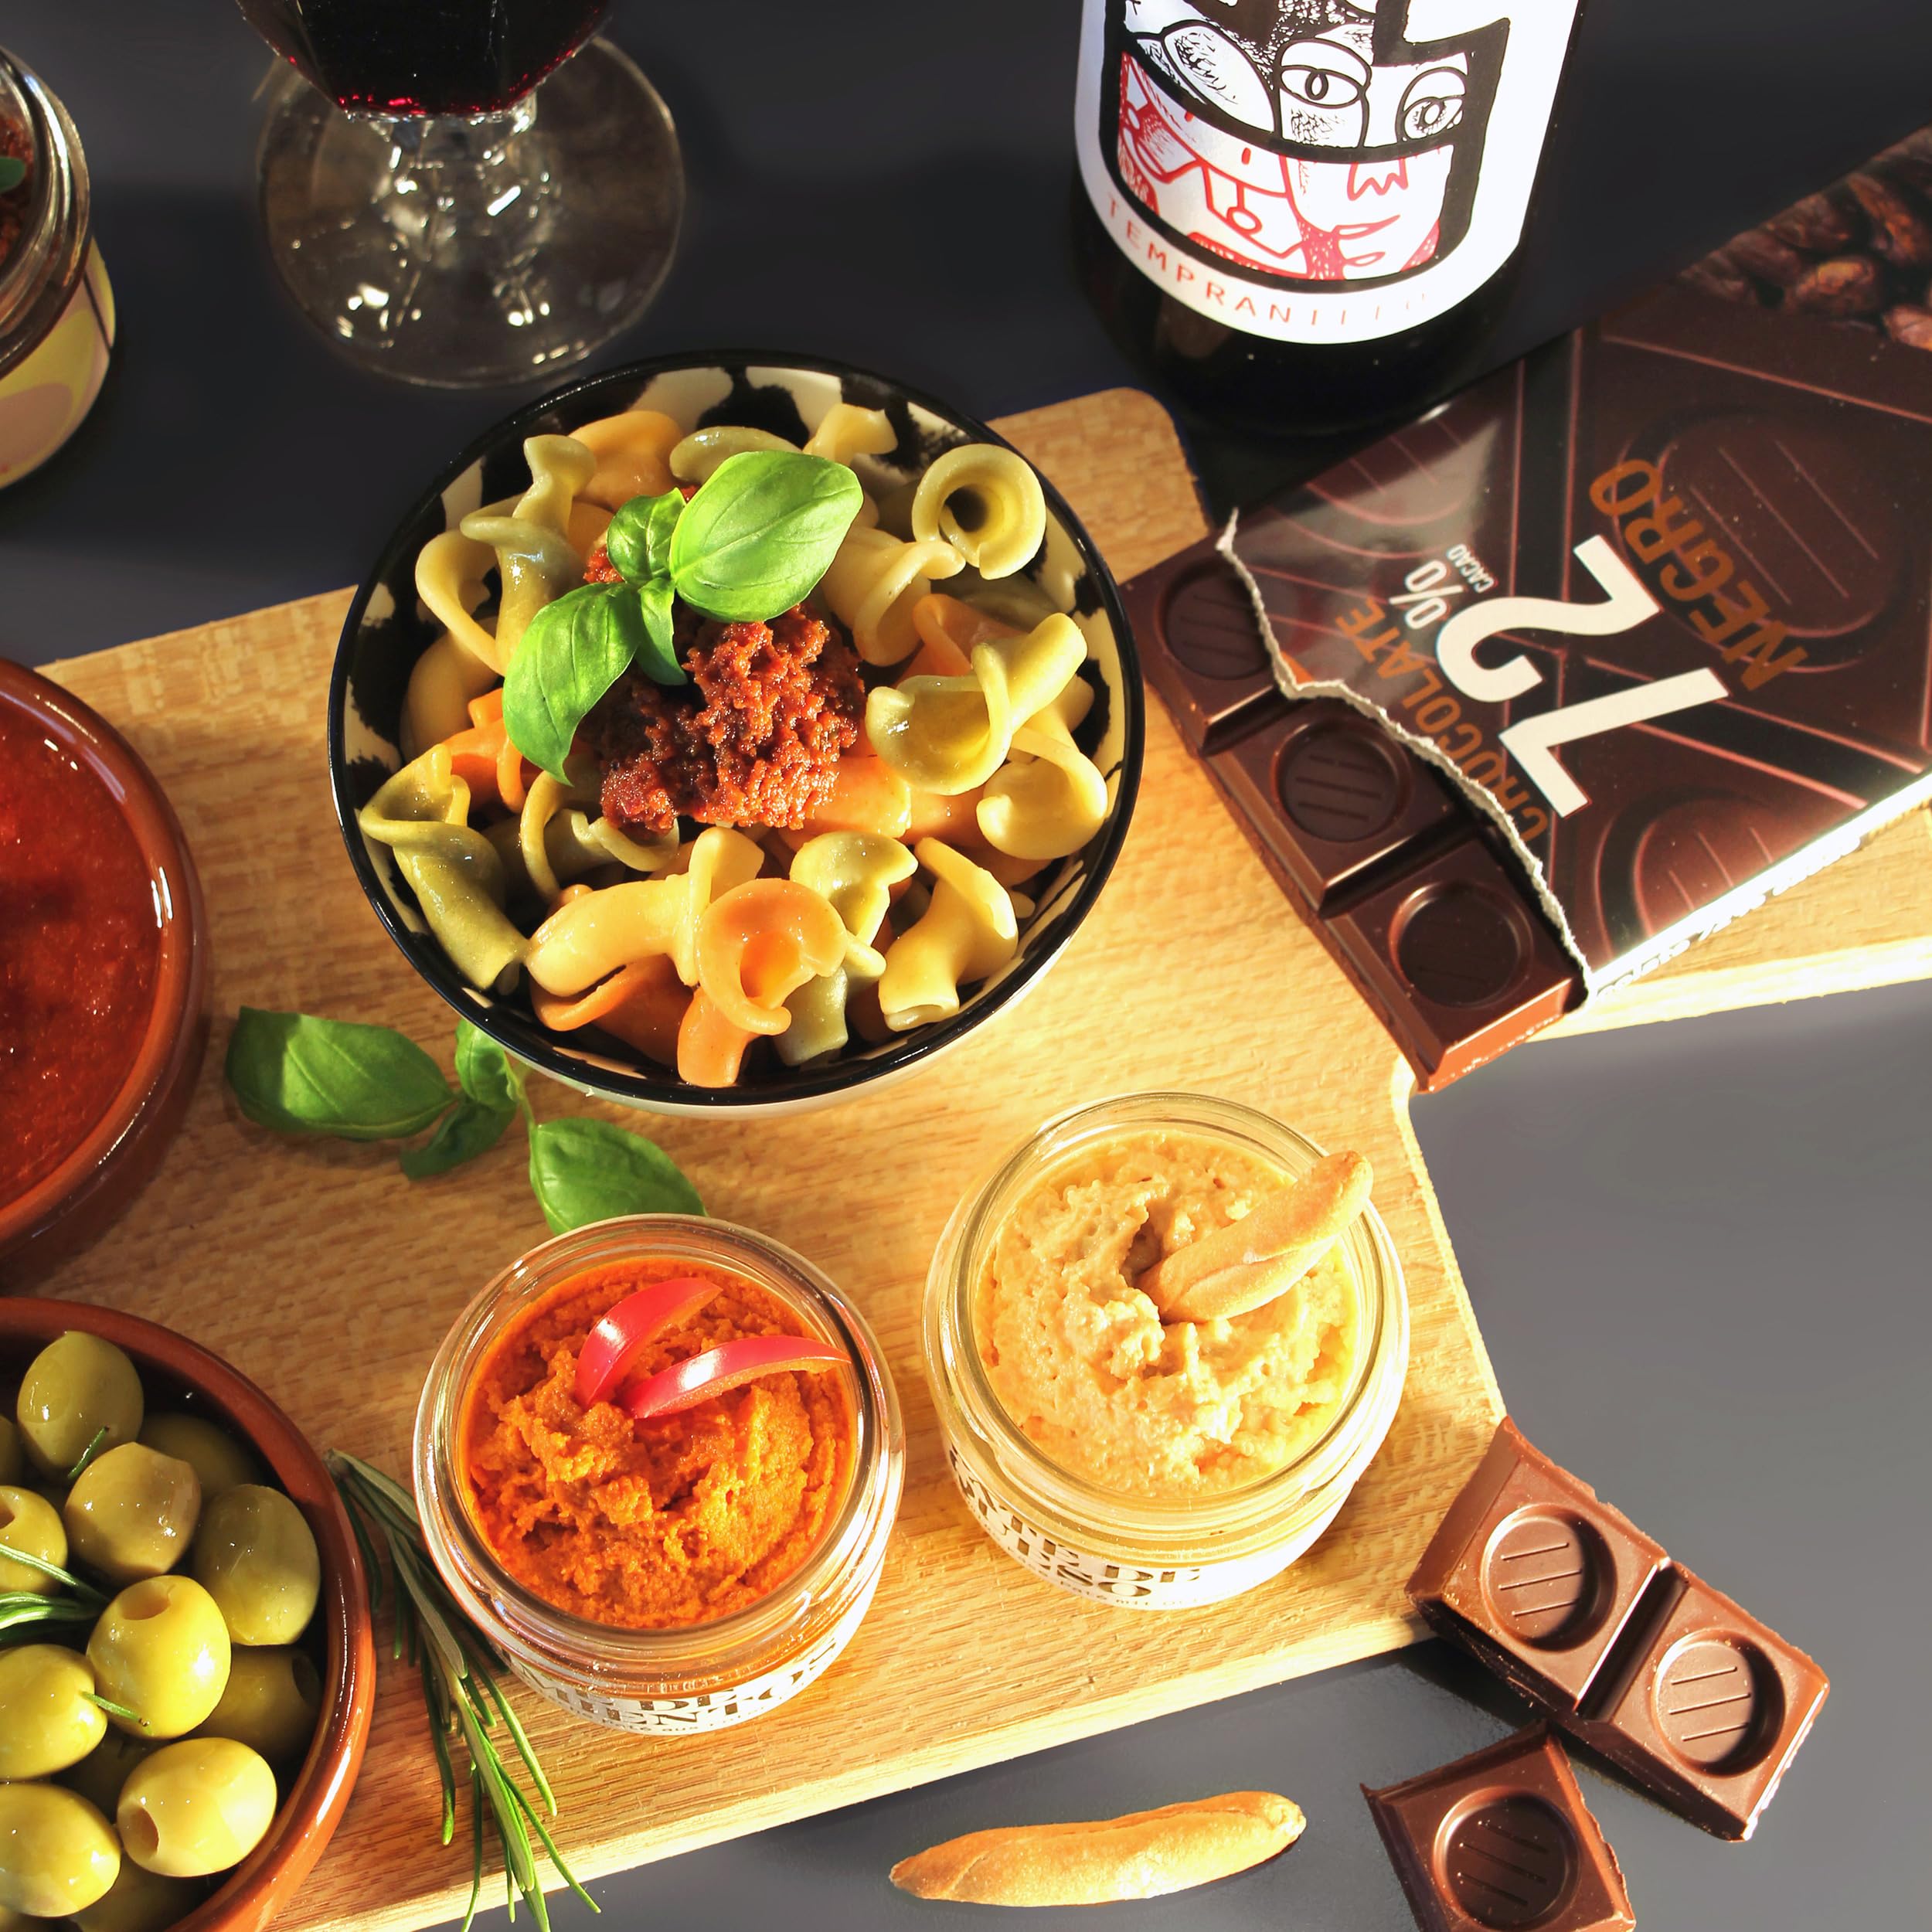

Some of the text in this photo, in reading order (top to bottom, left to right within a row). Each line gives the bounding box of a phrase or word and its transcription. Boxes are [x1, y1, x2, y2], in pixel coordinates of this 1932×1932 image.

[1107, 194, 1427, 326] TEMPRANI
[1446, 543, 1498, 594] CACAO
[1589, 457, 1808, 692] NEGRO
